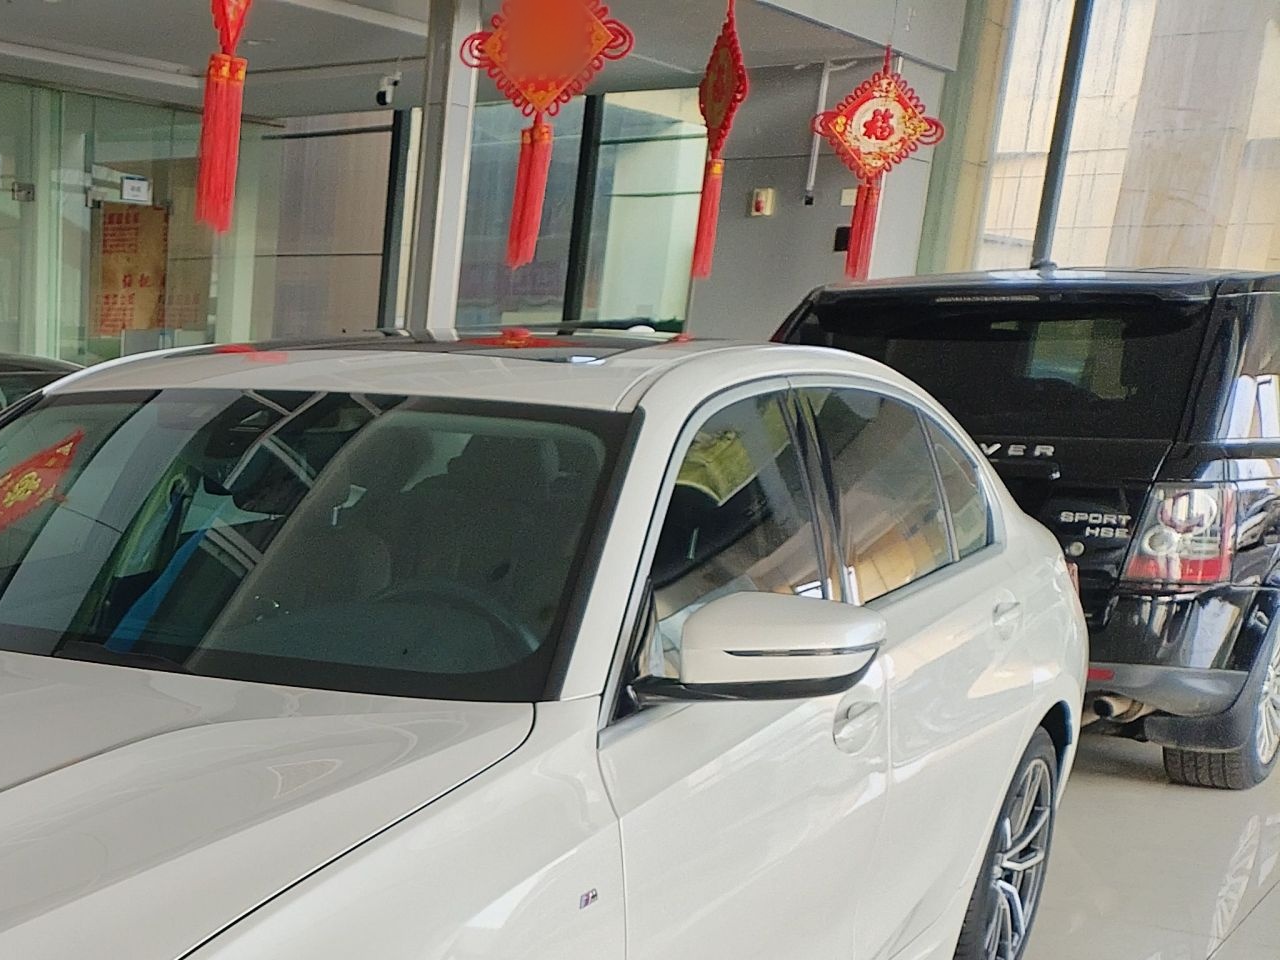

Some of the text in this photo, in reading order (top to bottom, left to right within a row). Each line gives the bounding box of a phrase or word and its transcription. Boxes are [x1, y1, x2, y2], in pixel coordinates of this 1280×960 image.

[863, 108, 894, 140] 福
[1060, 511, 1131, 525] SPORT
[1085, 527, 1130, 538] HSE
